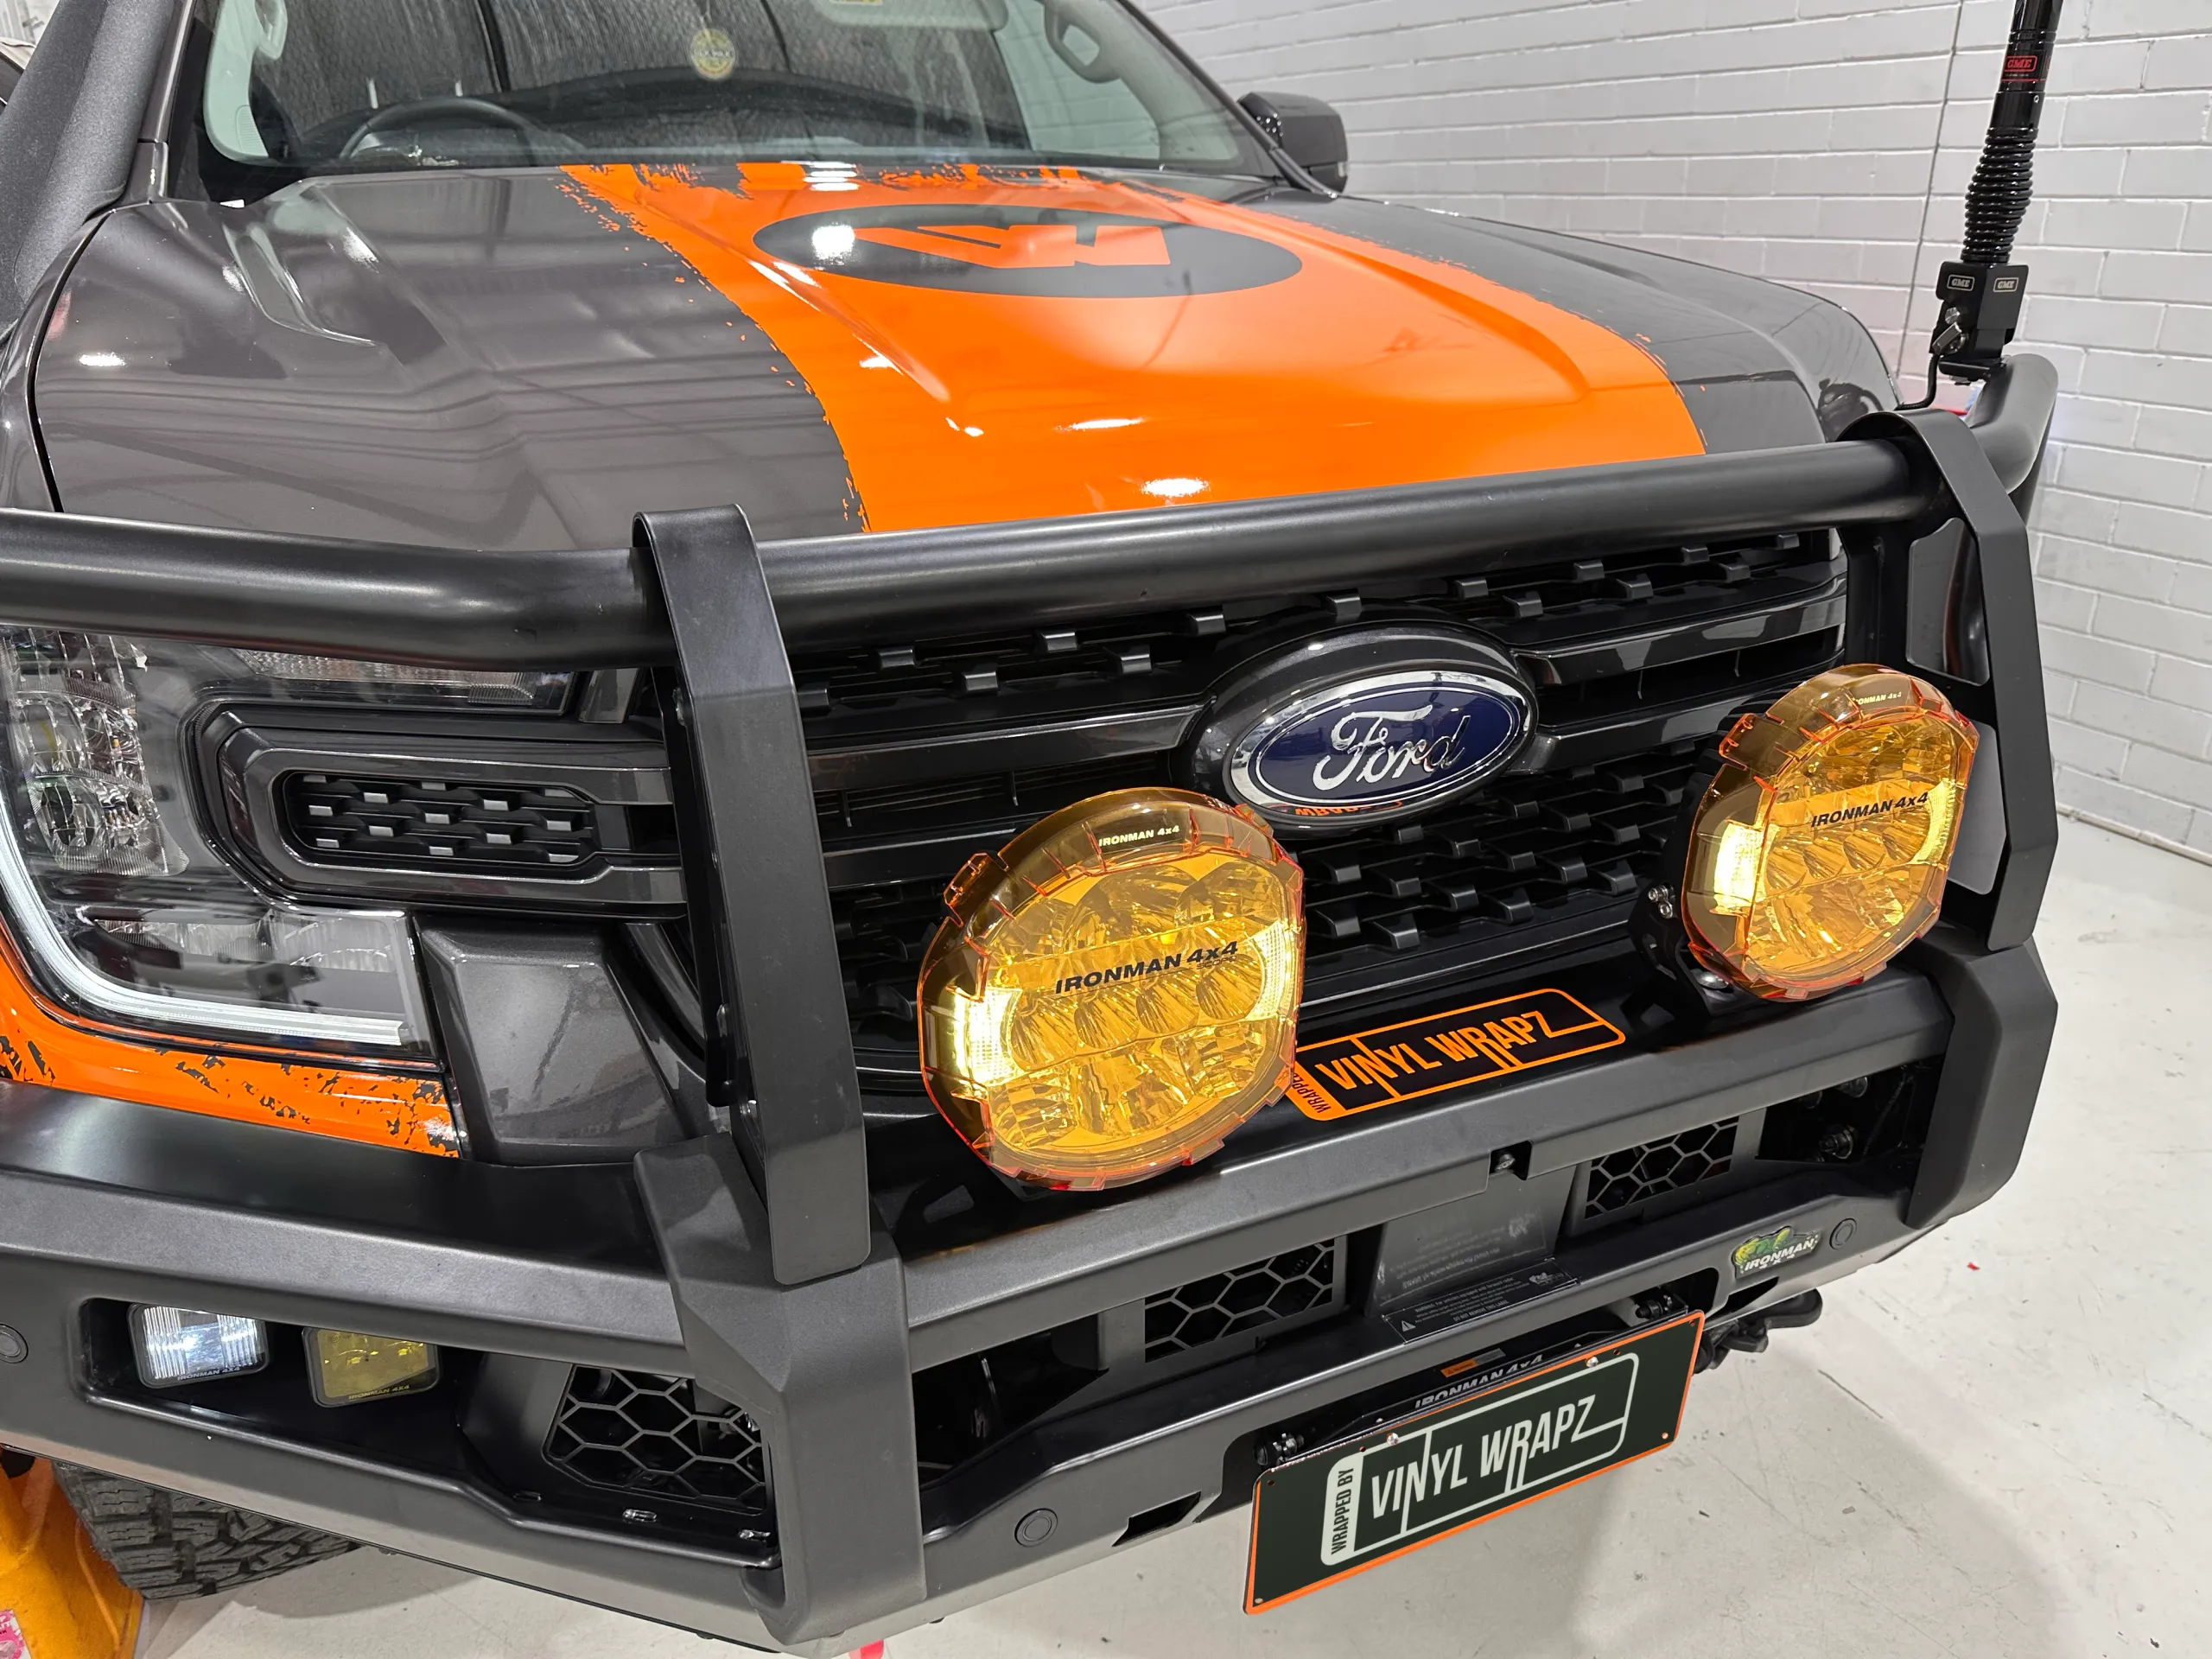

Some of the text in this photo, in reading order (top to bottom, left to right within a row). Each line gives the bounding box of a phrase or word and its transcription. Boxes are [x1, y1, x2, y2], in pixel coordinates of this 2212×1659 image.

[2007, 59, 2032, 68] GME
[1951, 278, 1970, 288] GME
[1997, 281, 2015, 289] GME
[1853, 694, 1886, 705] ONMAN
[1312, 704, 1471, 791] Ford
[1810, 791, 1929, 828] IRONMAN 4x4
[1098, 825, 1179, 847] IRONMAN 4x4
[1055, 941, 1238, 995] IRONMAN 4x4
[1314, 1010, 1556, 1091] VINYL WRAPZ
[1744, 1237, 1815, 1272] IRONMAN
[177, 1370, 220, 1381] IRONMAN
[348, 1389, 390, 1400] IRONMAN
[1371, 1394, 1597, 1520] VINYL WRAPZ
[1331, 1467, 1355, 1555] WRAPPED BY
